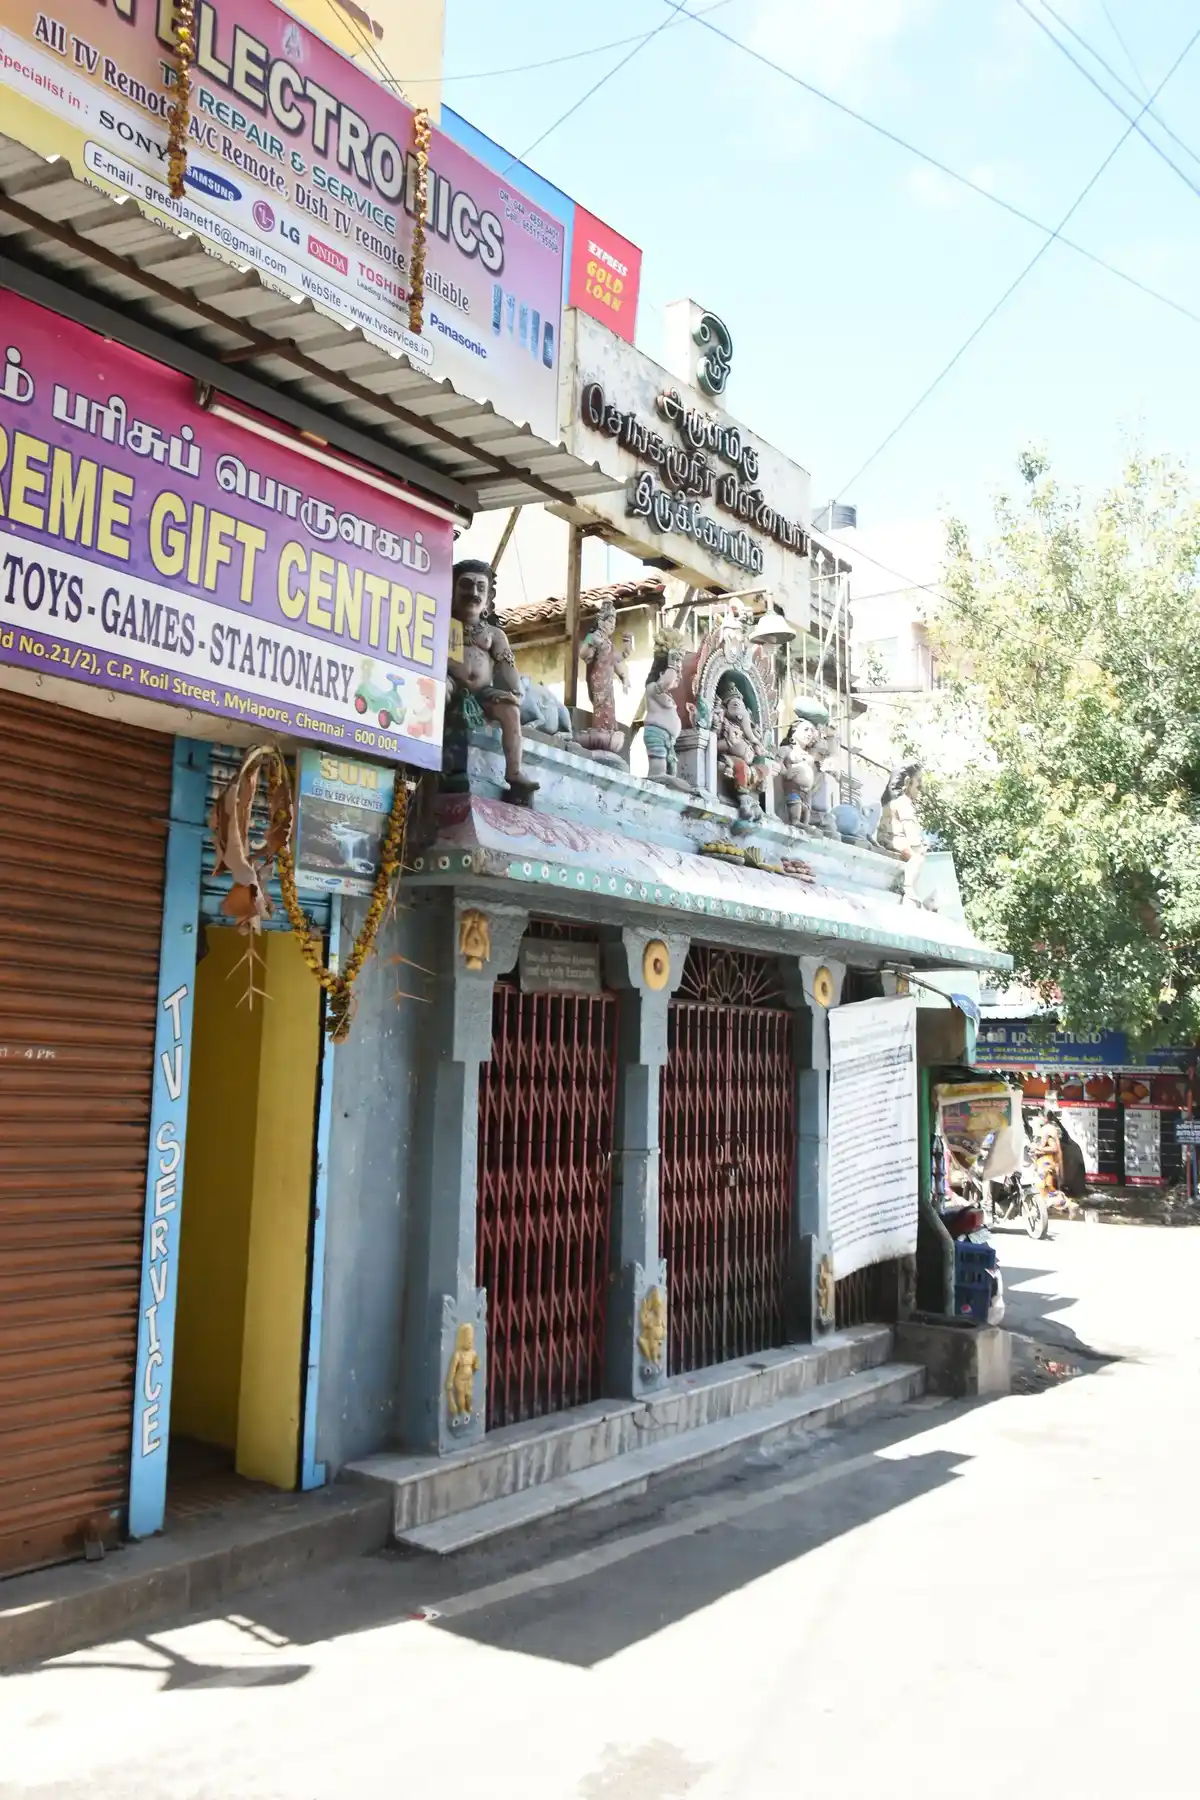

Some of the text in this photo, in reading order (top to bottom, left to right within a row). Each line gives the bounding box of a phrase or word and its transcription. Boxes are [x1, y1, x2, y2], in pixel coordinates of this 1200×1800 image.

[36, 14, 65, 53] All
[72, 37, 98, 71] TV
[190, 116, 218, 151] A/C
[222, 143, 289, 196] Remote,
[295, 182, 328, 222] Dish
[334, 208, 352, 234] TV
[355, 221, 406, 271] remote
[426, 271, 470, 314] ailable
[199, 89, 285, 161] REPAIR
[291, 152, 305, 173] &
[312, 167, 396, 235] SERVICE
[94, 152, 133, 187] E-mail
[145, 186, 288, 275] greenjanet16@gmail.com
[301, 273, 341, 307] WebSite
[99, 109, 168, 162] SONY
[186, 167, 235, 201] SAMSUNG
[281, 220, 300, 245] LG
[310, 241, 346, 271] ONIDA
[430, 312, 488, 360] Panasonic
[587, 261, 624, 294] GOLD
[588, 240, 628, 277] EXPRESS
[382, 294, 411, 315] Innovati
[586, 279, 623, 312] LOAN
[51, 383, 202, 479] பரிசுப்
[149, 491, 267, 606] GIFT
[277, 540, 438, 668] CENTRE
[107, 659, 135, 683] C.P.
[140, 668, 169, 692] Koil
[172, 676, 220, 707] Street,
[224, 691, 293, 726] Mylapore,
[296, 711, 345, 740] Chennai
[354, 728, 376, 746] 600
[320, 758, 378, 791] SUN
[141, 1120, 181, 1459] SERVICE
